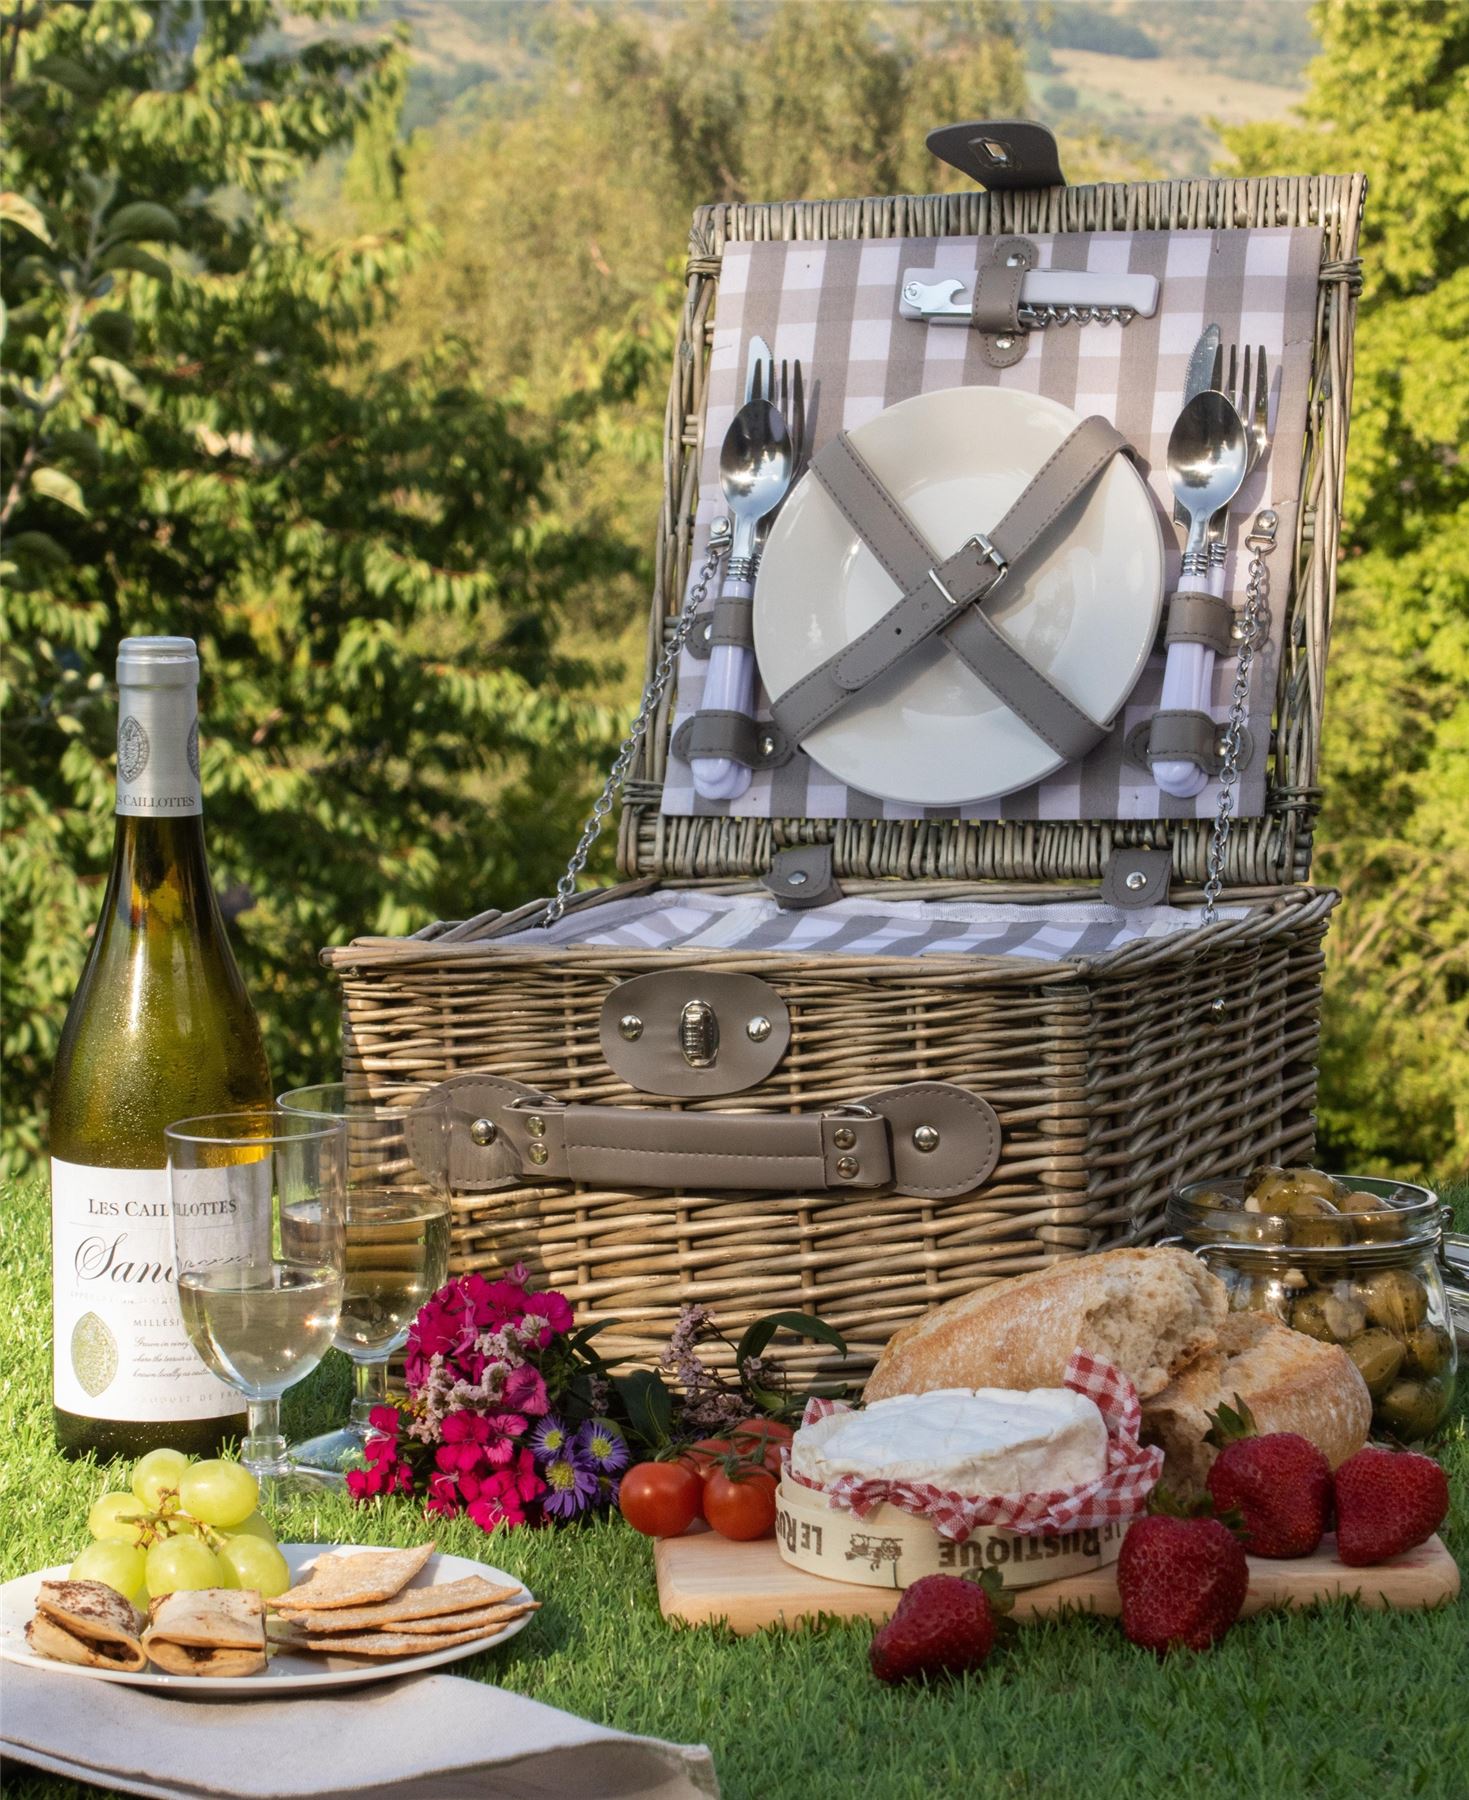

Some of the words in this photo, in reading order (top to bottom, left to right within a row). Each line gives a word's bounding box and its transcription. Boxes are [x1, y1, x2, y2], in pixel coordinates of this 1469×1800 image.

[124, 794, 195, 807] CAILLOTTES
[88, 1198, 119, 1215] LES
[801, 1518, 822, 1556] LE
[938, 1527, 1100, 1568] RUSTIQUE
